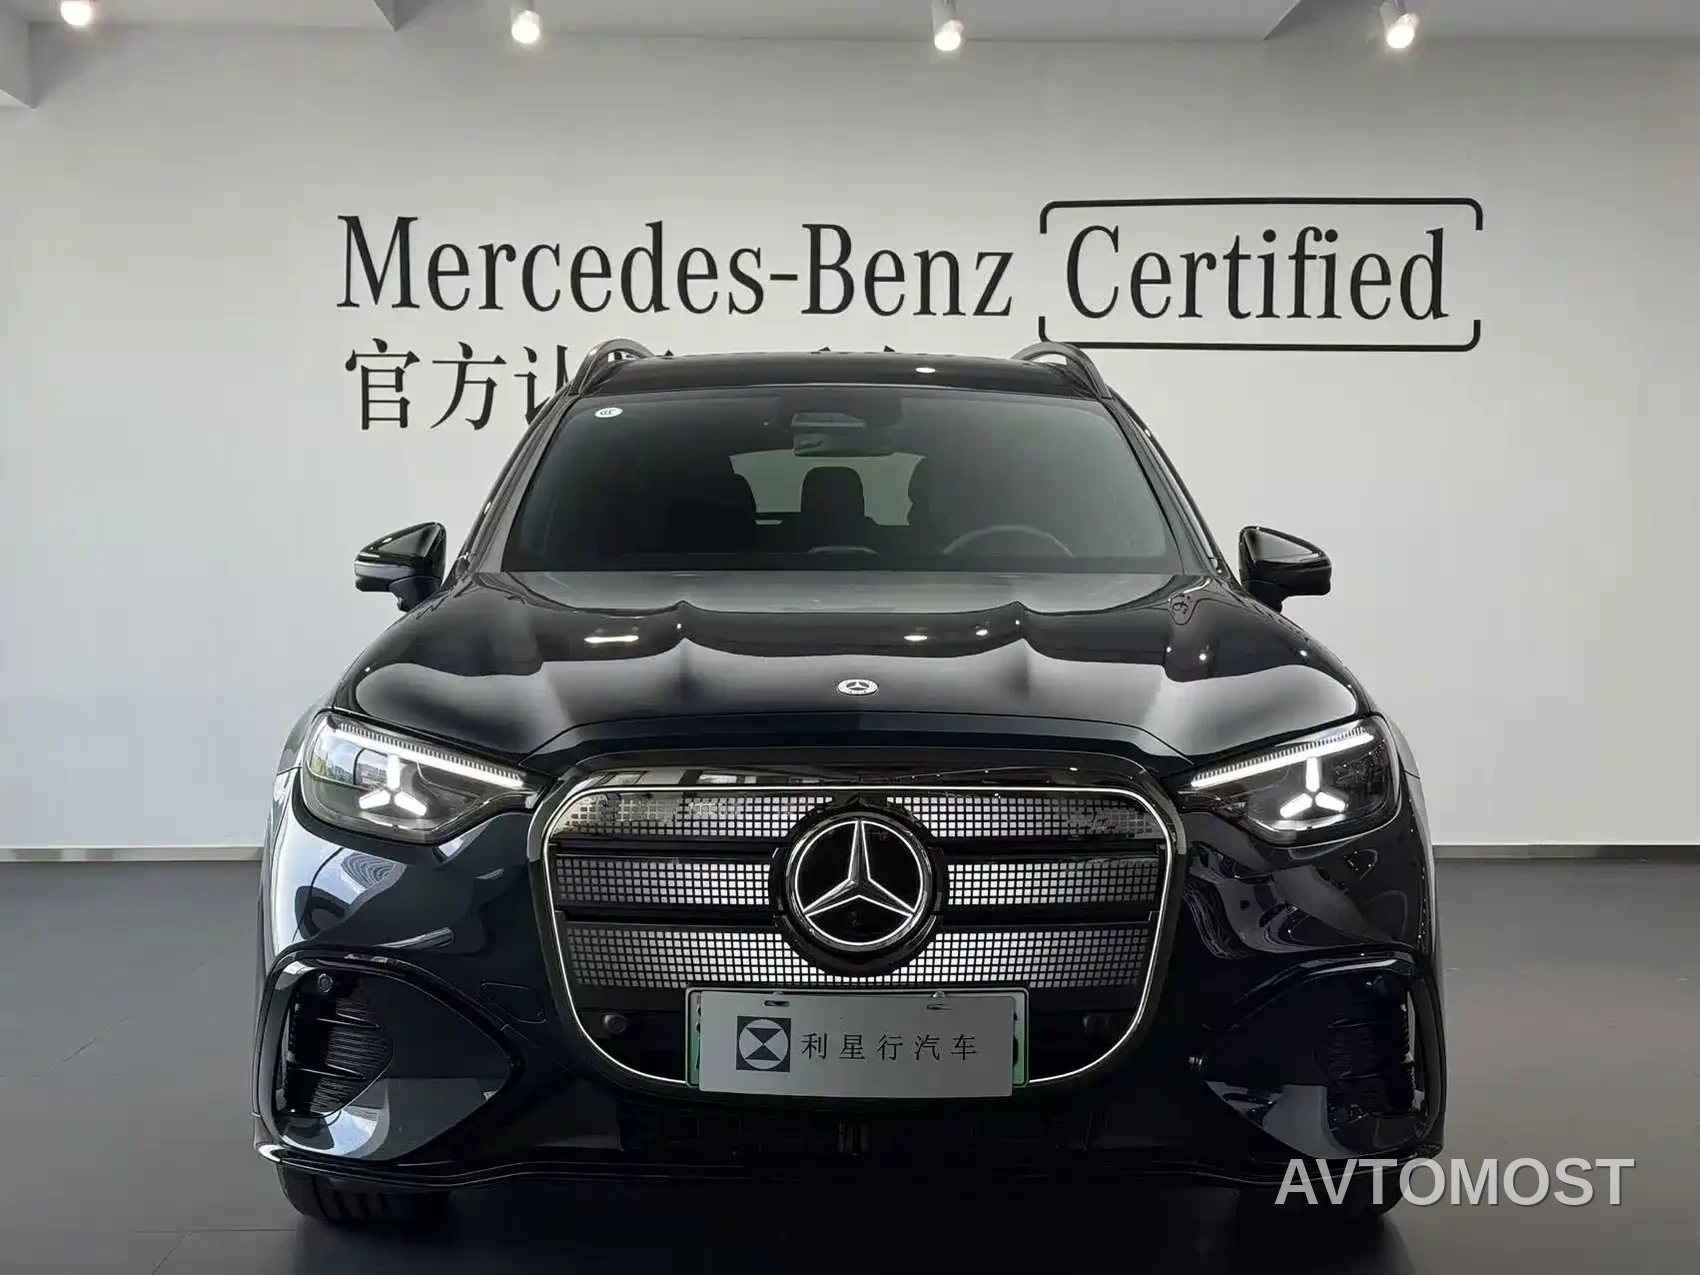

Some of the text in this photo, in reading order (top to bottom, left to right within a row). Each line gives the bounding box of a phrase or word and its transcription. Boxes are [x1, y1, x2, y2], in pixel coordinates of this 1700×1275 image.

[336, 215, 1449, 321] Mercedes-Benz Certified
[801, 1032, 977, 1061] 利星行汽车
